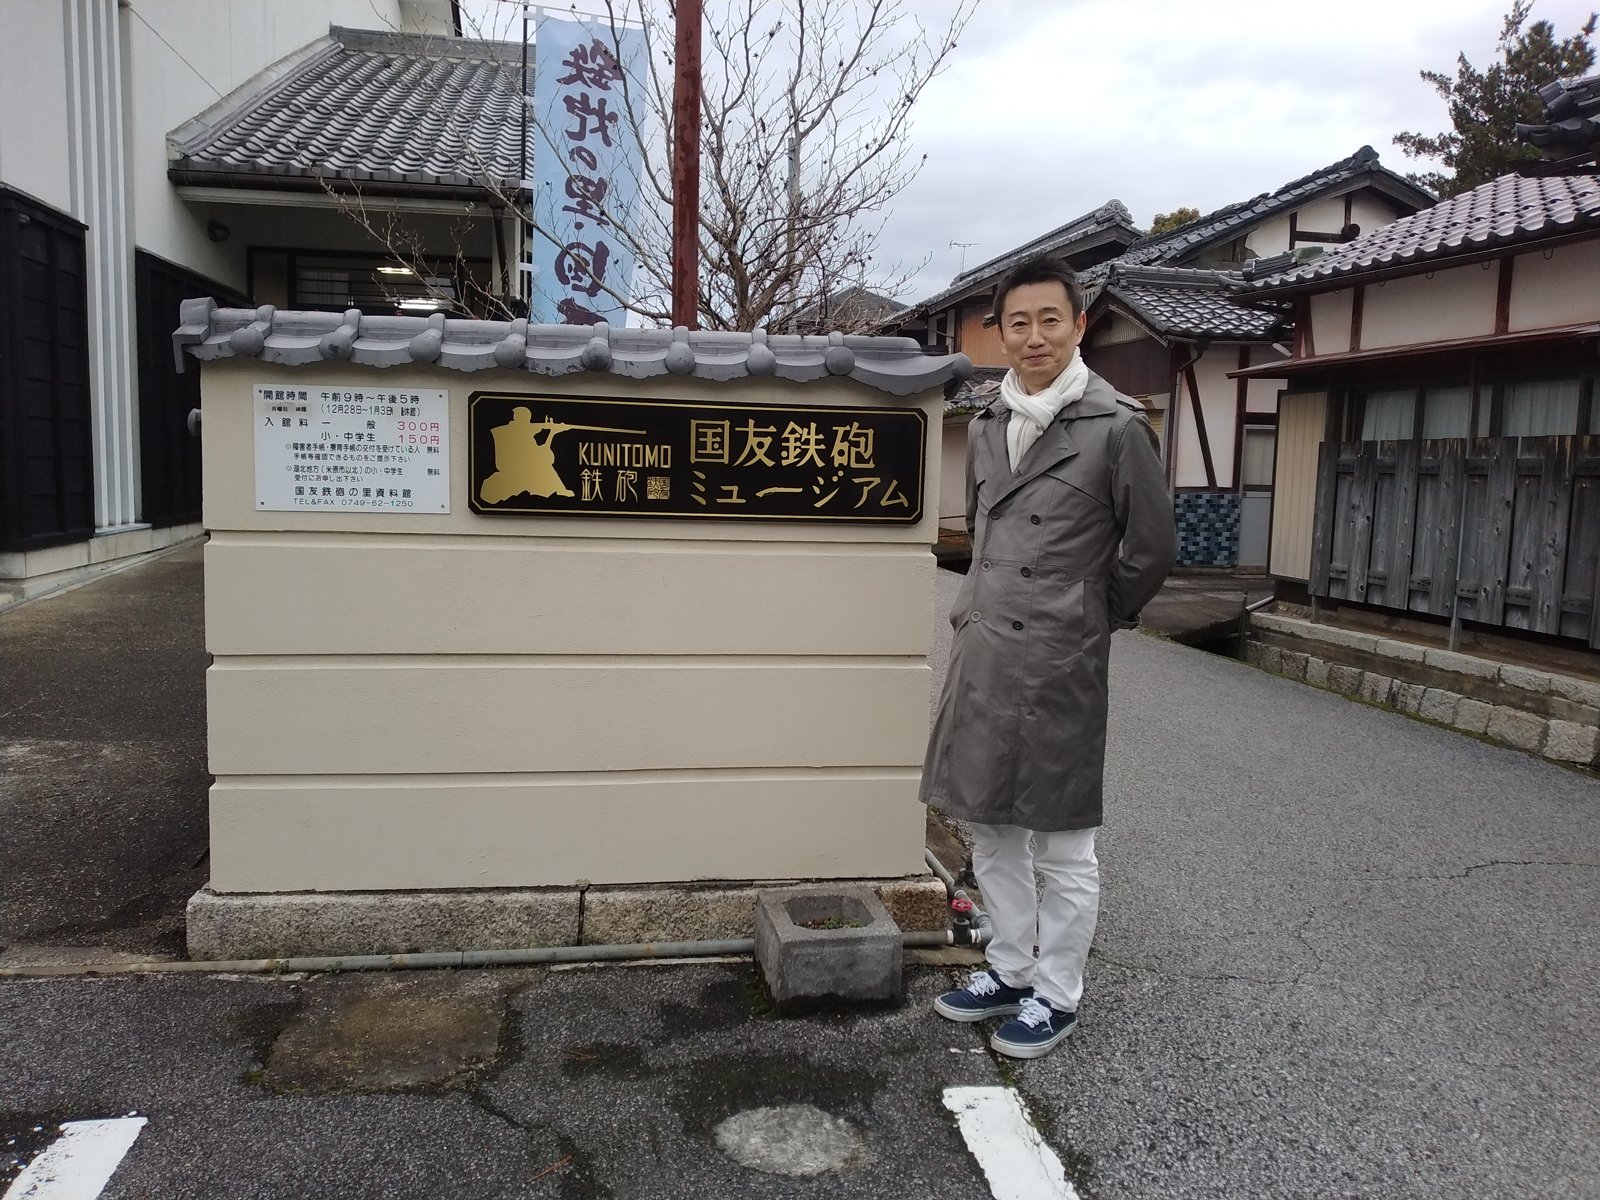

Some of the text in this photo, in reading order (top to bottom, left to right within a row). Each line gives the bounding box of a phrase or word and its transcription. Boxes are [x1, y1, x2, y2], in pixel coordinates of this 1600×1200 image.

[263, 389, 308, 401] 開館時間
[264, 417, 309, 428] 入館料
[397, 421, 440, 432] 300円
[320, 431, 440, 445] 小・中学生 150円
[689, 418, 875, 470] 国友鉄砲
[426, 446, 440, 454] 無料
[579, 441, 672, 469] KUNITOMO
[427, 468, 440, 476] 無料
[294, 486, 412, 499] 国友鉄砲の里資料館
[579, 468, 639, 503] 鉄砲
[689, 470, 910, 510] ミュージアム
[293, 498, 414, 508] TEL&FAX 0749-62-1250
